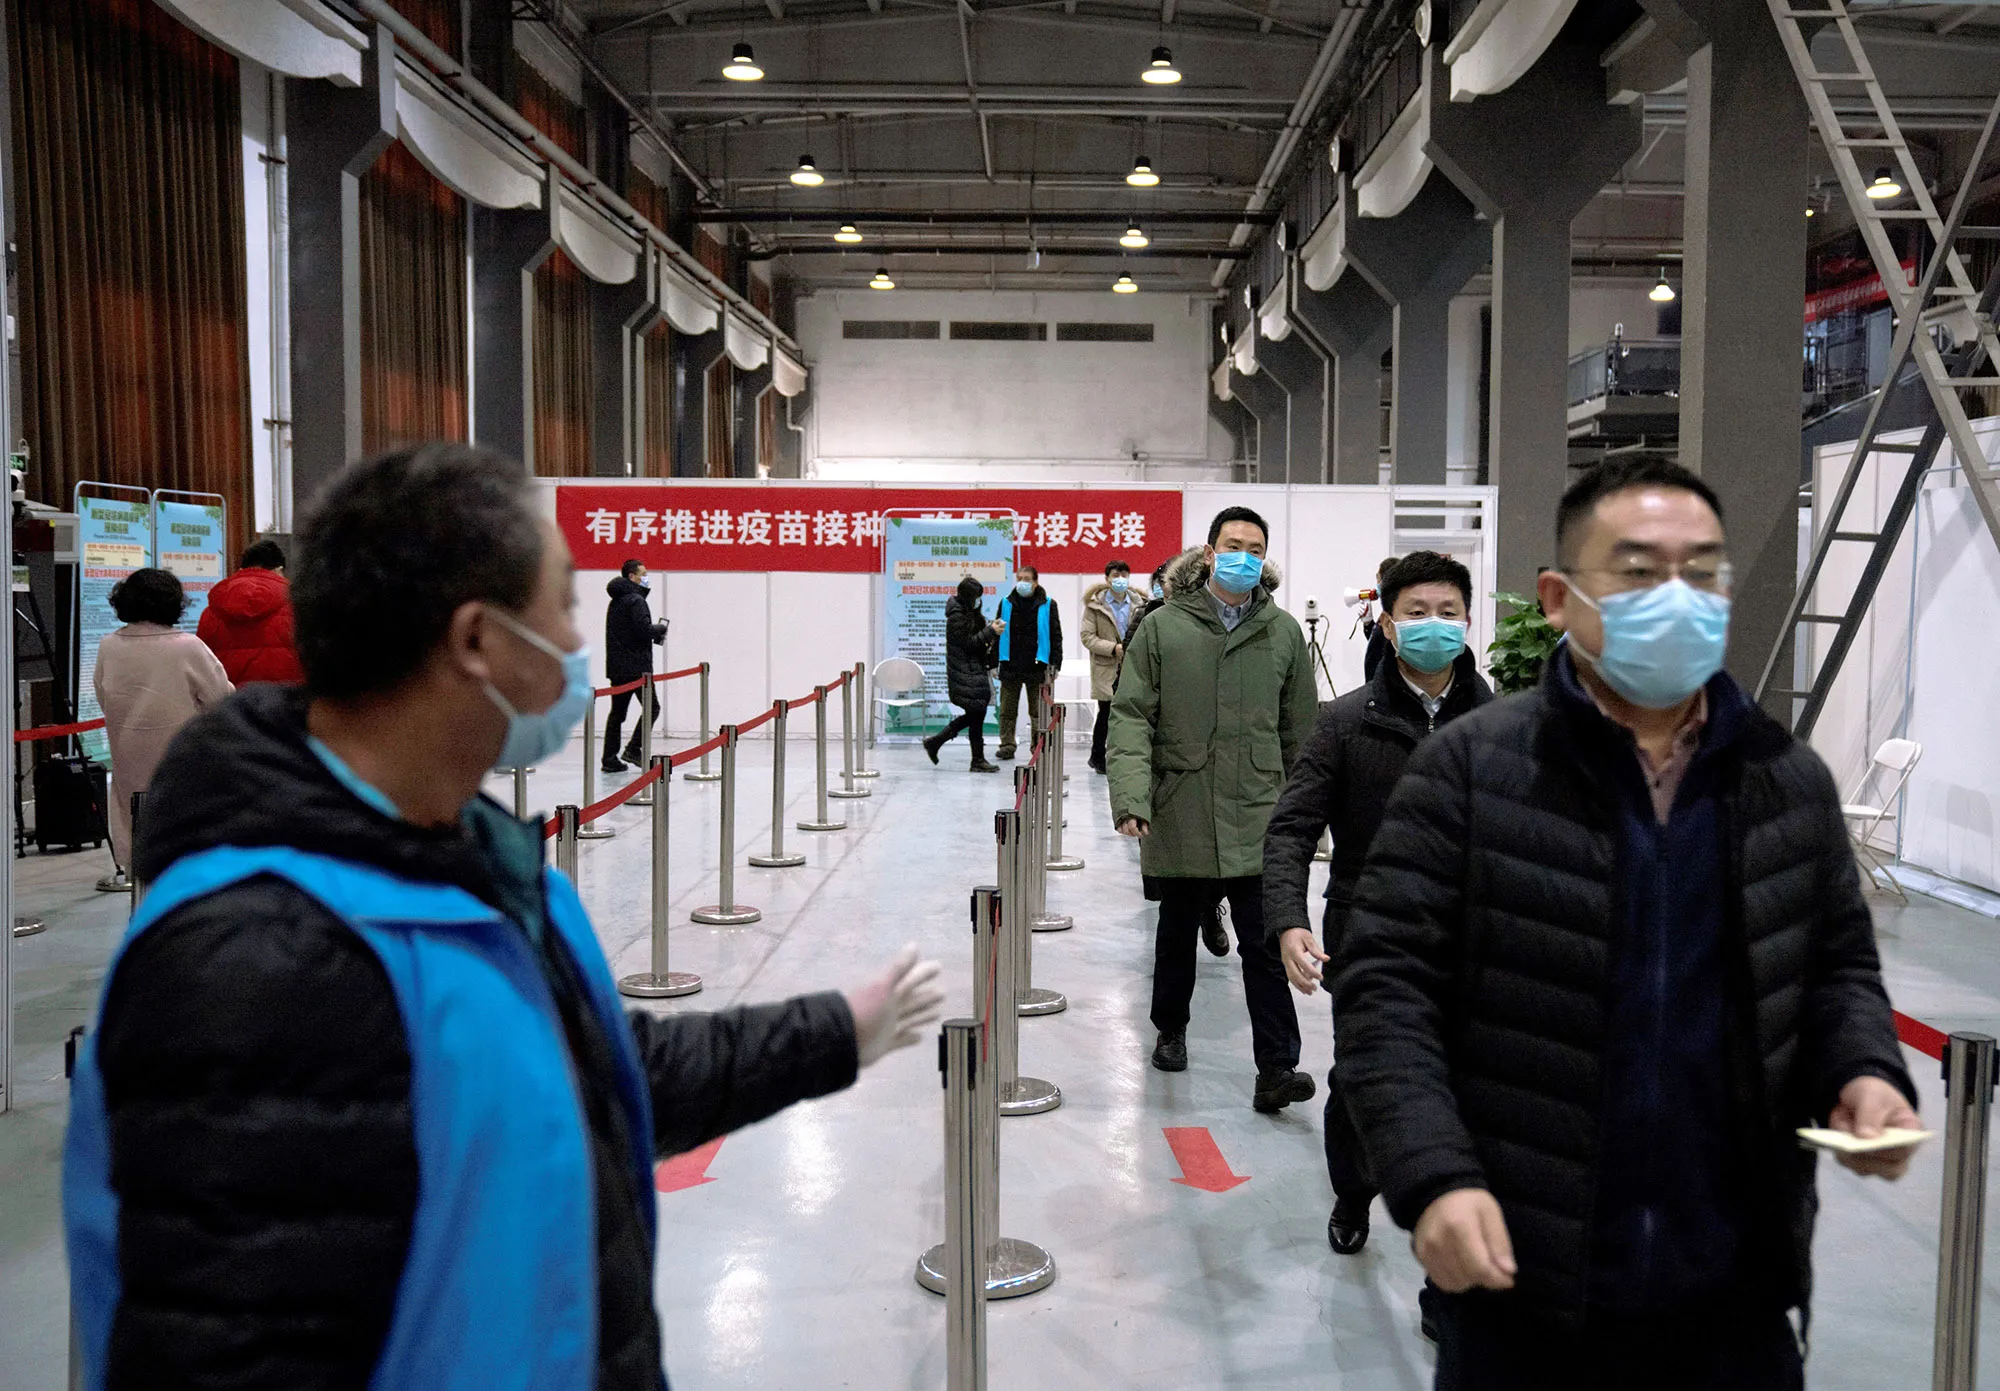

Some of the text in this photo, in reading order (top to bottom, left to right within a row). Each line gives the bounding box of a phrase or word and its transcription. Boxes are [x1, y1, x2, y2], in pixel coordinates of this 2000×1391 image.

[585, 507, 1146, 549] 有序推进疫苗接种 应接尽接
